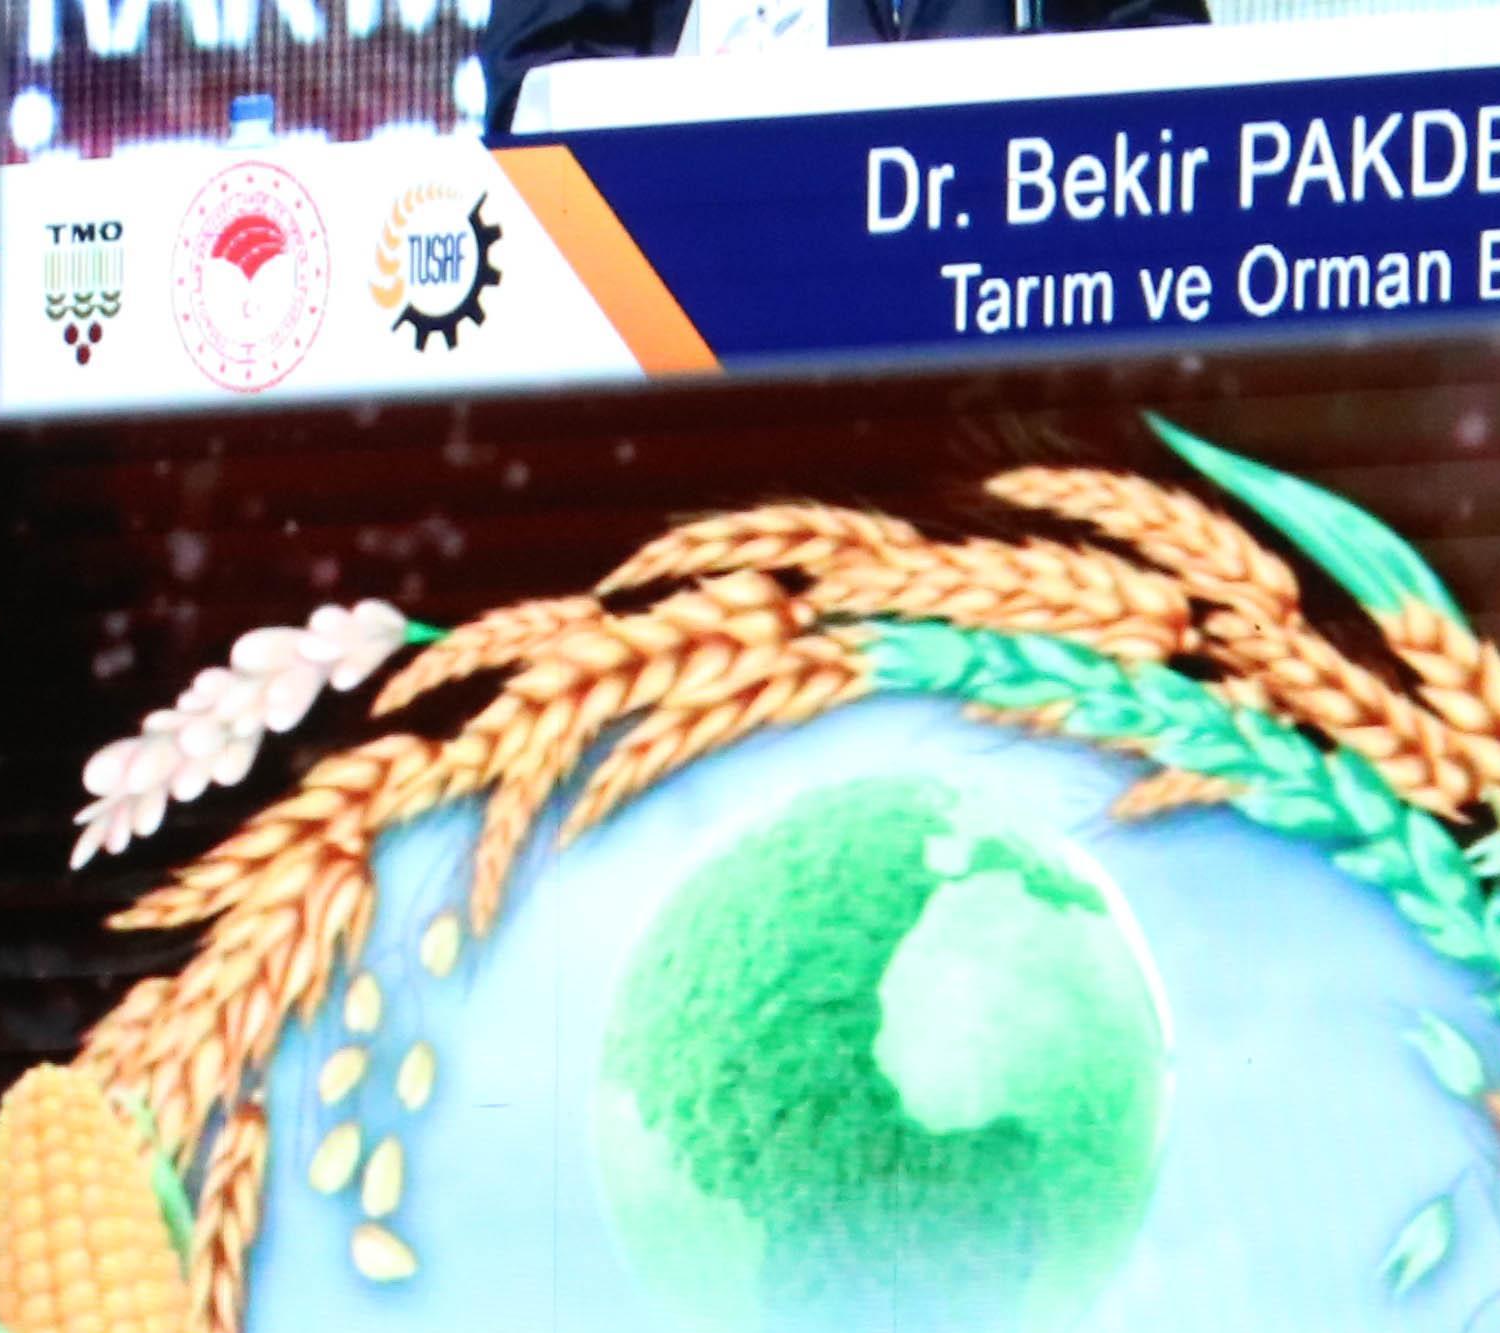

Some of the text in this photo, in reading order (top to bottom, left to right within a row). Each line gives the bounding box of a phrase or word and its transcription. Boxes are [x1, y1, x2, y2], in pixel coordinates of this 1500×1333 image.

[866, 144, 972, 235] Dr.
[1004, 130, 1209, 225] Bekir
[45, 220, 124, 245] TMO
[408, 230, 467, 287] TUSAF
[940, 262, 1115, 334] Tarım
[1138, 266, 1211, 322] ve
[1236, 244, 1453, 319] Orman
